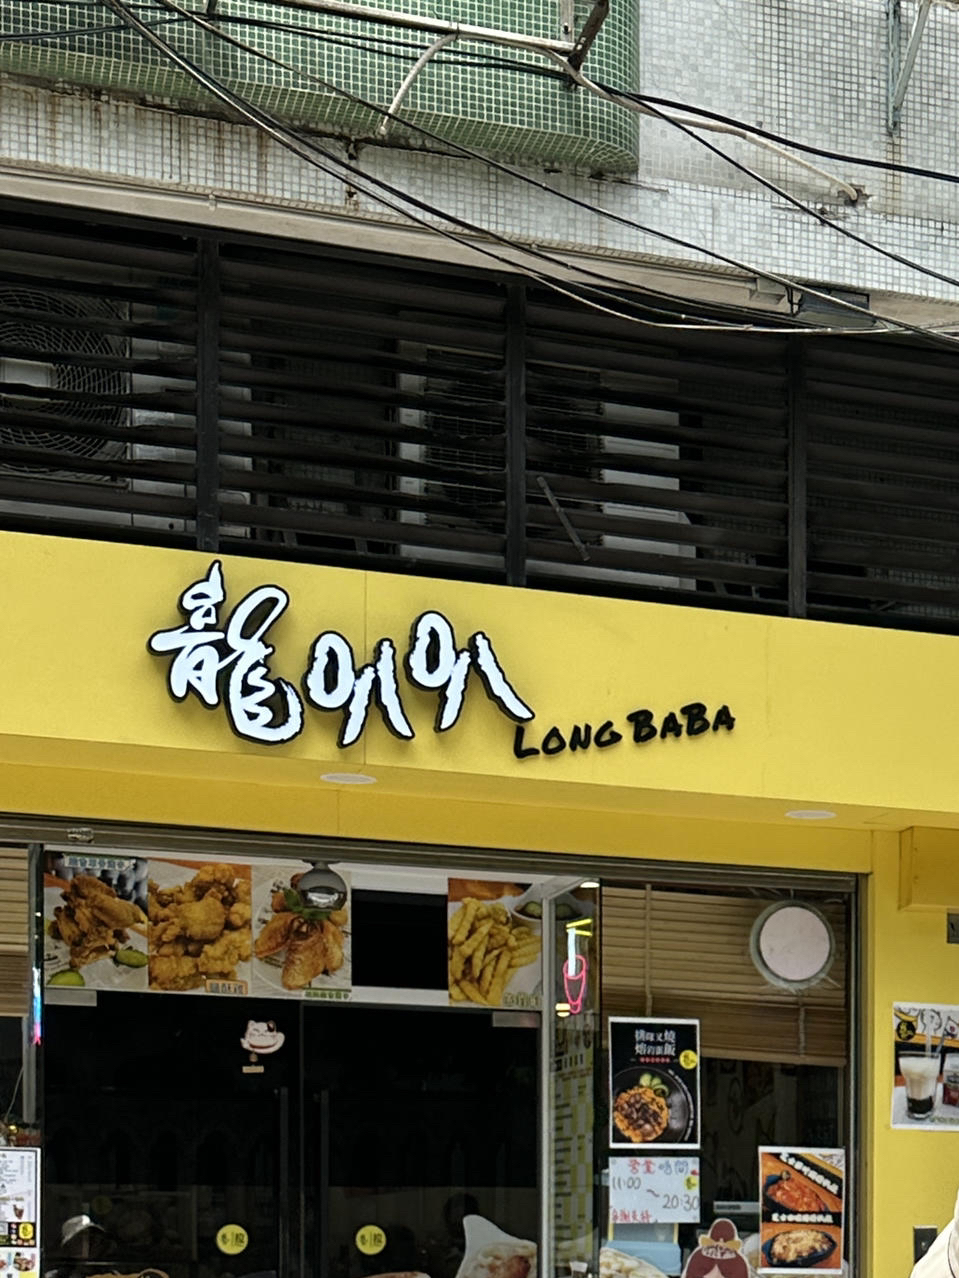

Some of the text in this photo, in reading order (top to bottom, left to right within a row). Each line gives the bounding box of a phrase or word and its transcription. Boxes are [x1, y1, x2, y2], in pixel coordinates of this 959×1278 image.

[514, 703, 735, 759] LONG BABA
[662, 1194, 700, 1211] 20:30
